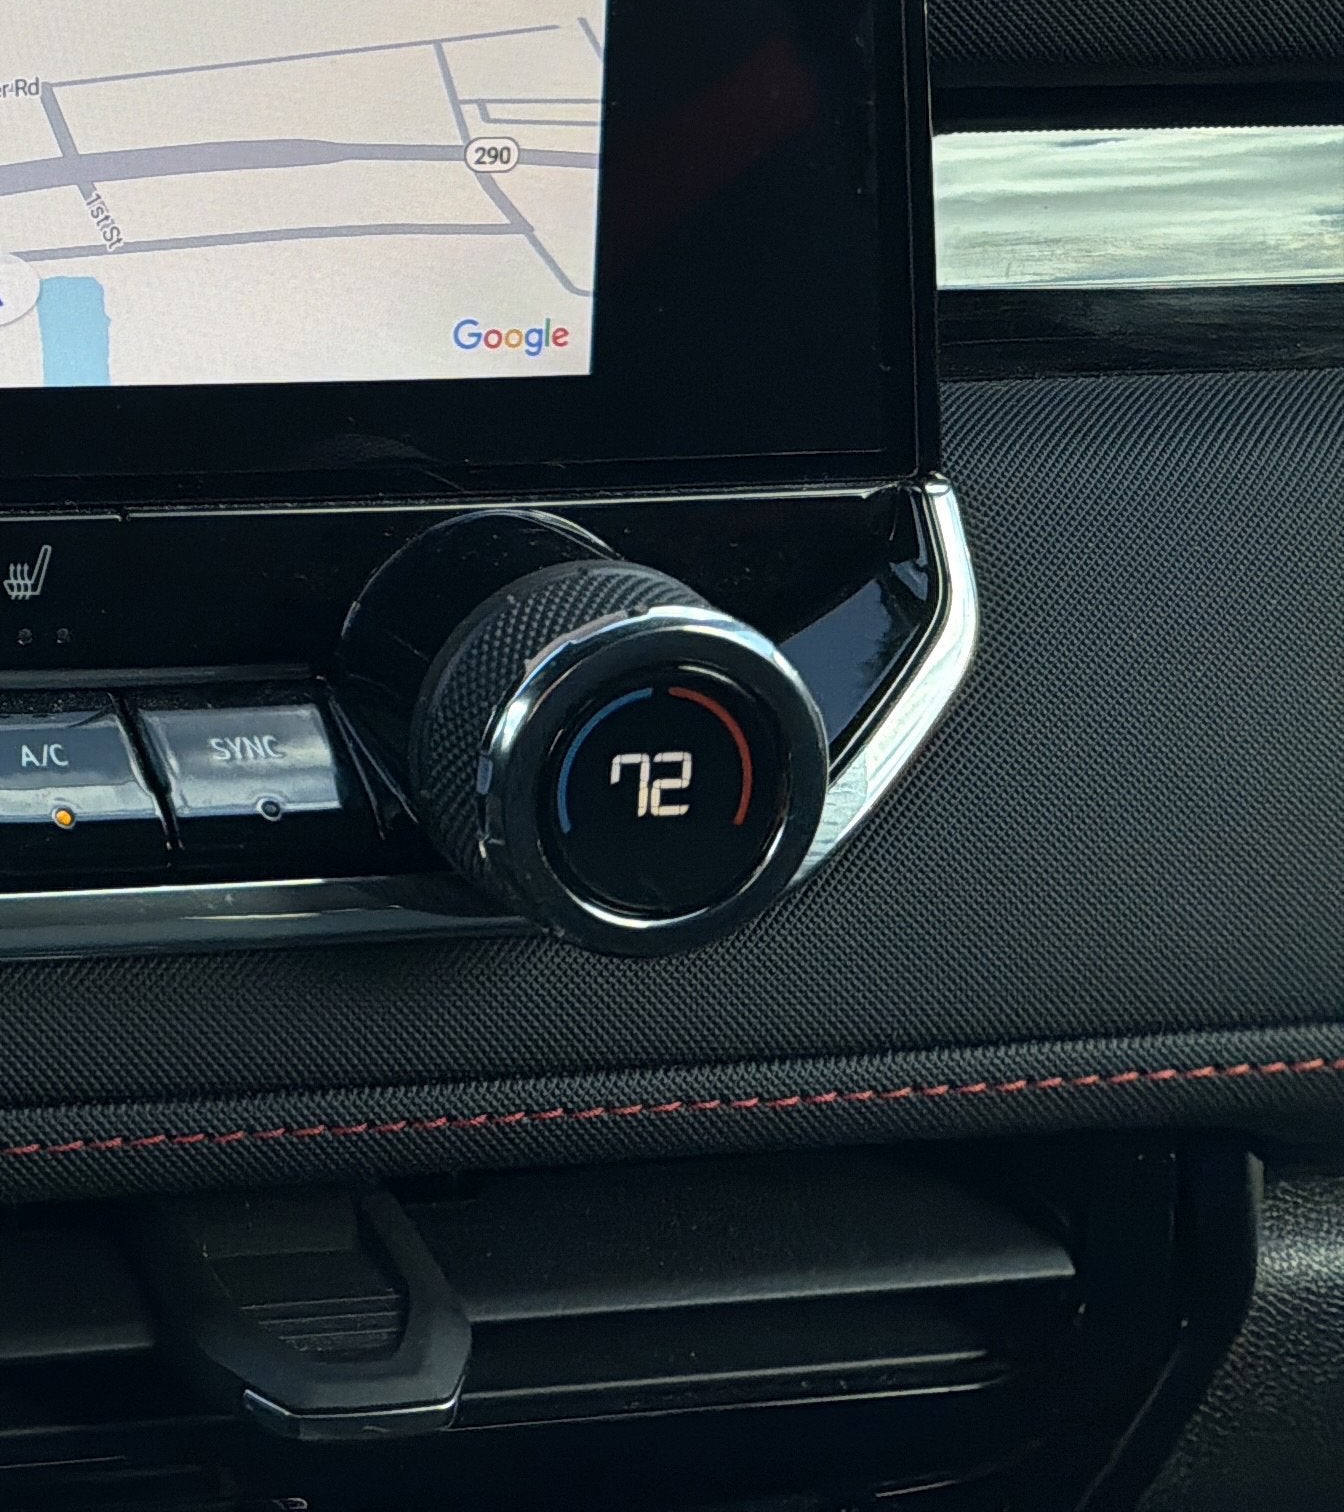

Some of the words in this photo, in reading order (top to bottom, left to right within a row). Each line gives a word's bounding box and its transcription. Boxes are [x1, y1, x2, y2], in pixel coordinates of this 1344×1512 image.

[15, 76, 41, 97] Rd
[473, 145, 512, 165] 290
[86, 191, 111, 226] 1st
[99, 224, 124, 249] St
[452, 317, 570, 357] Google
[18, 740, 69, 770] A/C
[209, 732, 284, 764] SYNC
[610, 751, 692, 818] 72
